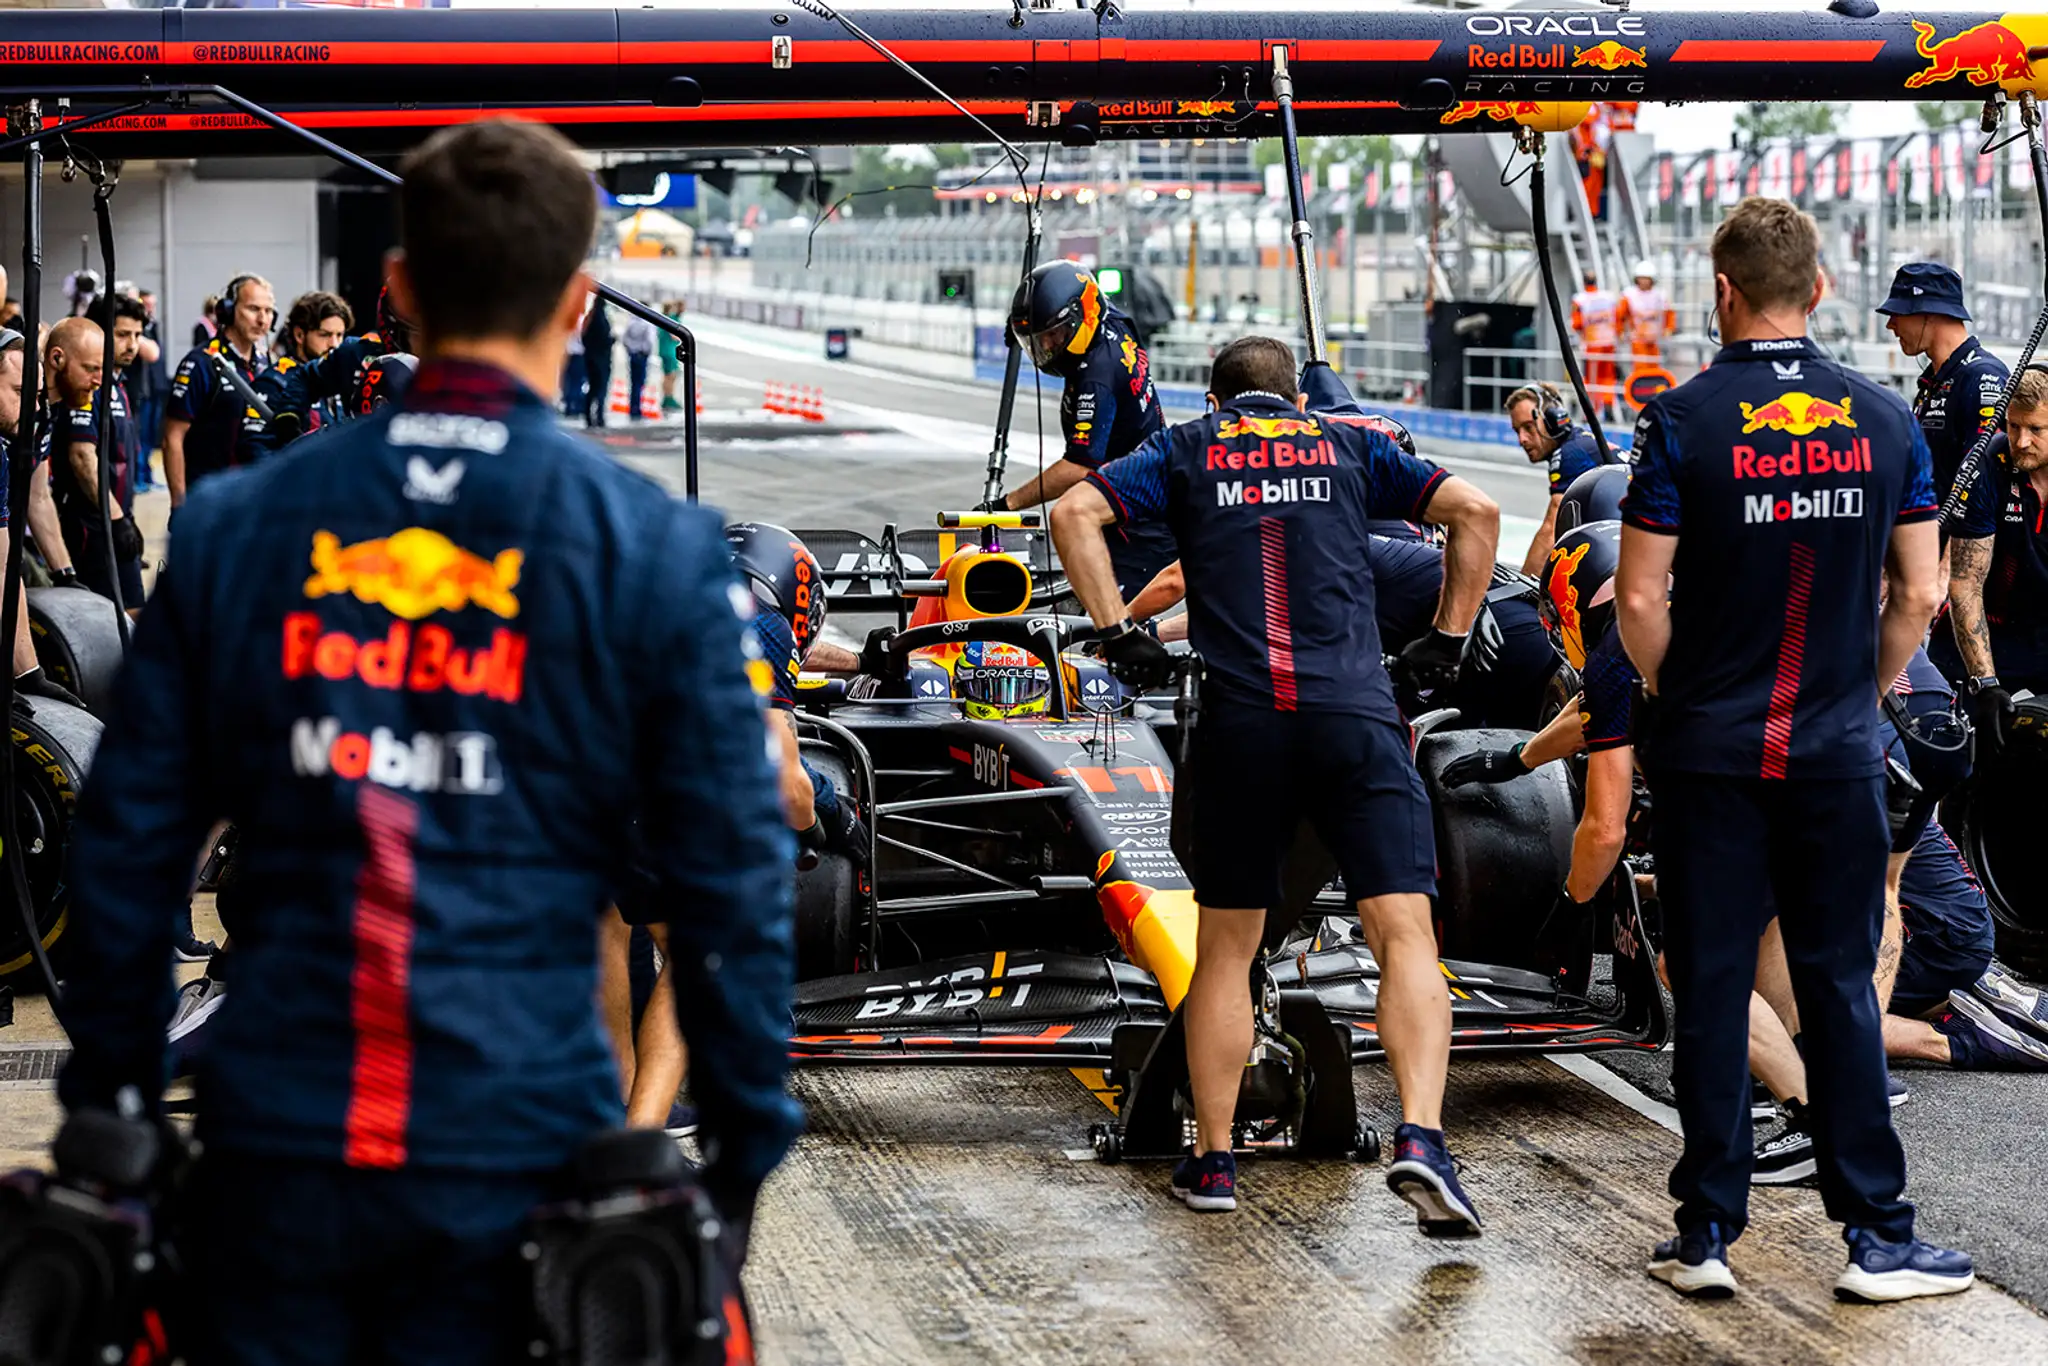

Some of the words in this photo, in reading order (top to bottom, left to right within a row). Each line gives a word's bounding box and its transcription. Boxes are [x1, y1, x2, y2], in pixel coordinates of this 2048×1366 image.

[1465, 16, 1646, 36] ORACLE
[0, 45, 160, 62] REDBULLRACING.COM
[193, 45, 330, 62] @REDBULLRACING
[1468, 44, 1515, 68] Red
[1519, 44, 1565, 68] Bull
[1464, 81, 1645, 93] RACING
[1098, 101, 1135, 116] Red
[1137, 100, 1173, 115] Bull
[1100, 124, 1238, 134] RACING
[1751, 340, 1804, 351] HONDA
[1206, 440, 1270, 471] Red
[1273, 440, 1338, 467] Bull
[1732, 440, 1802, 479] Red
[1806, 437, 1872, 474] Bull
[1217, 478, 1299, 507] Mobil
[1744, 489, 1831, 524] Mobil
[788, 541, 815, 609] Red
[282, 611, 410, 690] Red
[408, 622, 528, 704] Bull
[984, 656, 1005, 667] Red
[1005, 656, 1024, 666] Bull
[975, 668, 1033, 679] ORACLE
[290, 716, 443, 792] Mobil
[974, 743, 1010, 792] BYBIT
[1052, 766, 1175, 793] 11
[855, 951, 1044, 1019] BYBIT
